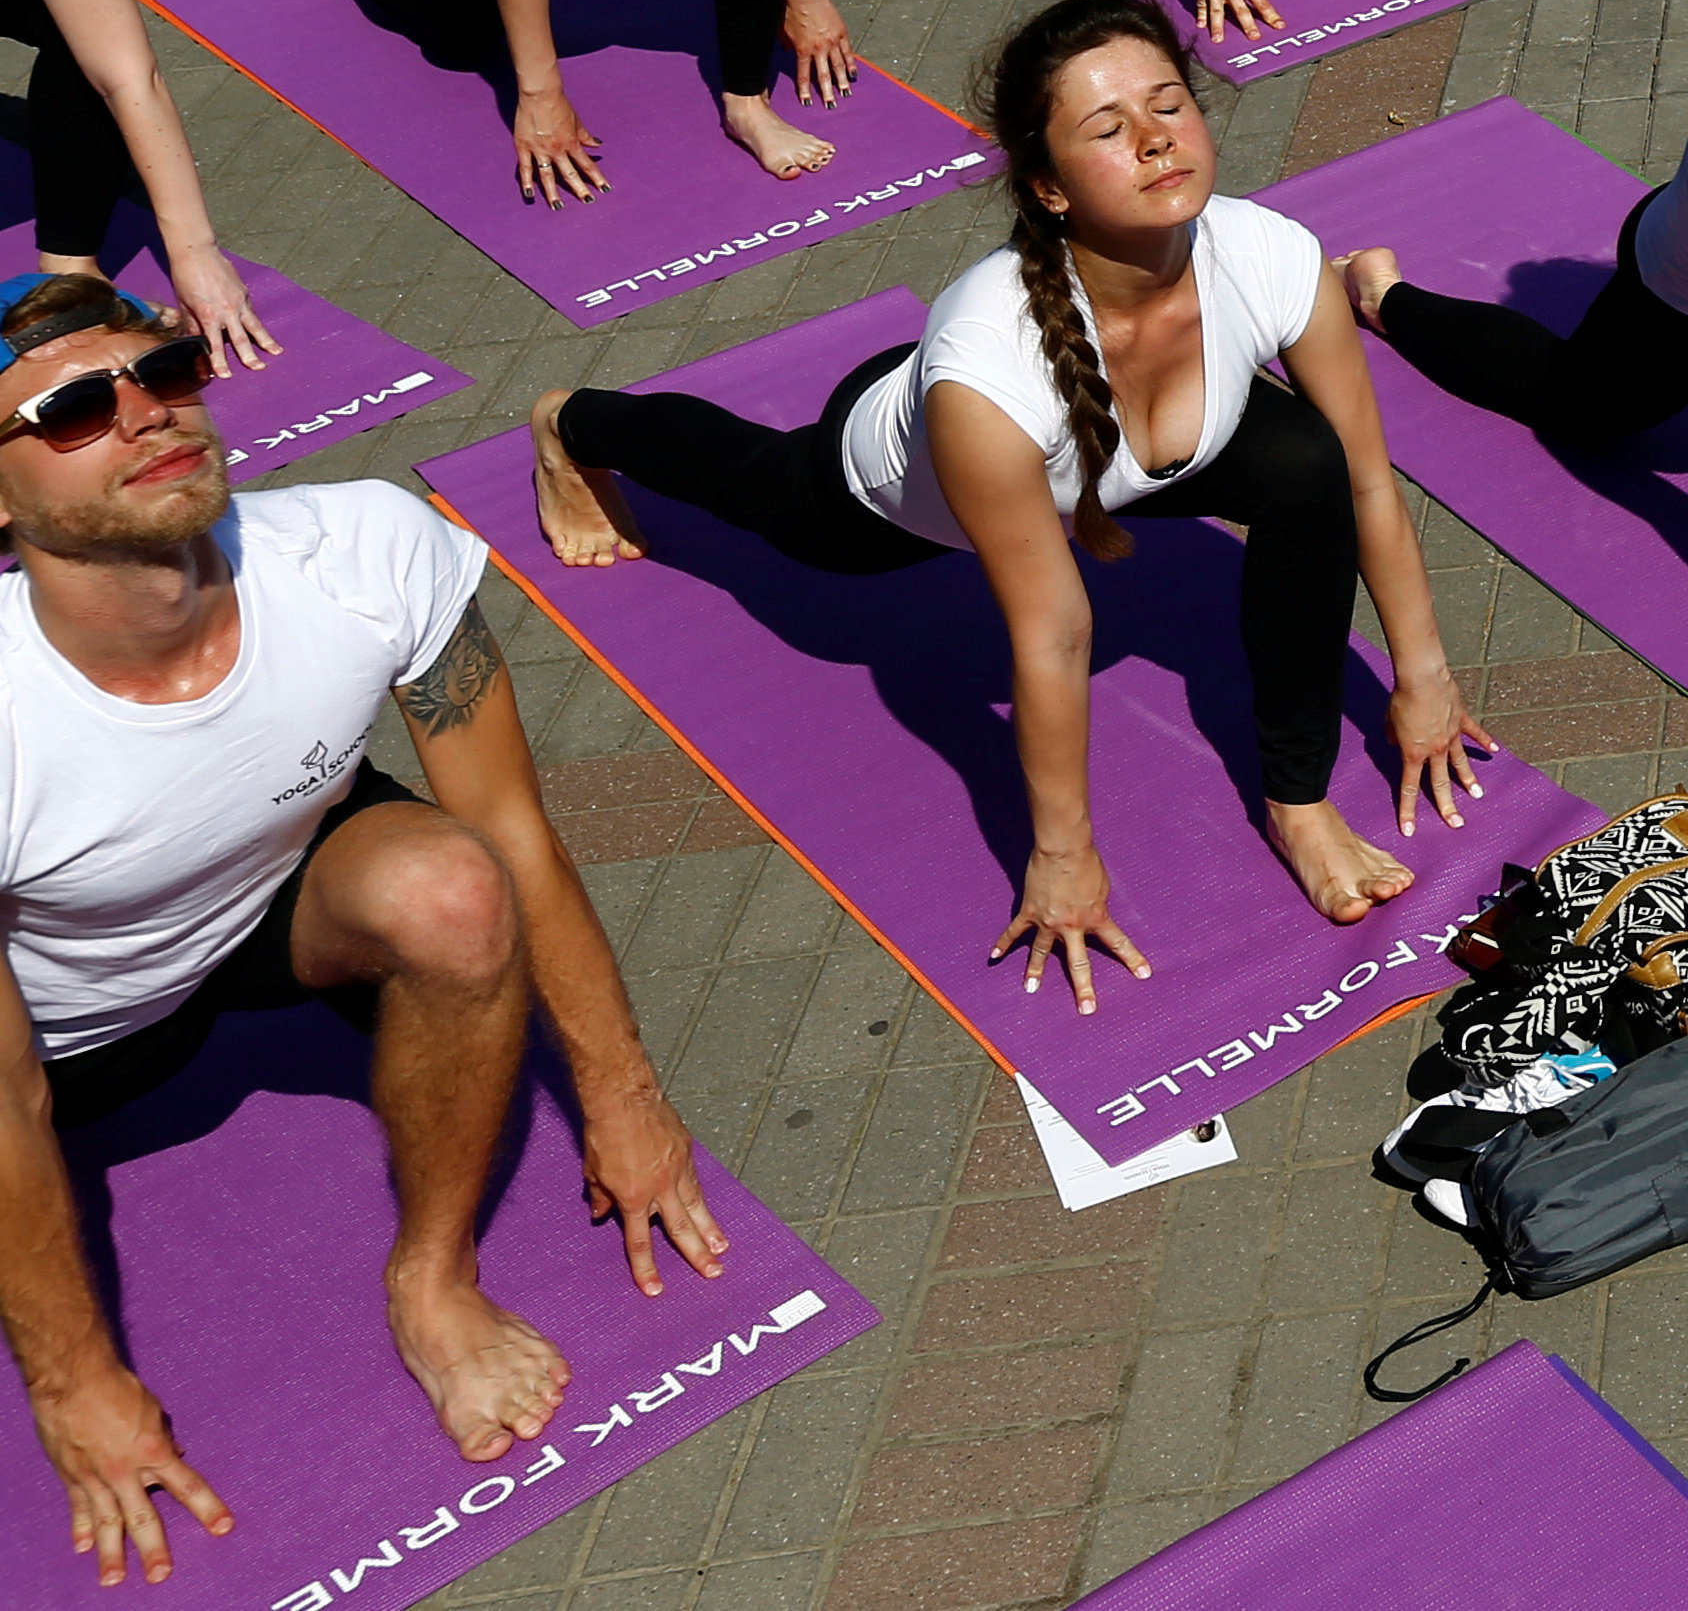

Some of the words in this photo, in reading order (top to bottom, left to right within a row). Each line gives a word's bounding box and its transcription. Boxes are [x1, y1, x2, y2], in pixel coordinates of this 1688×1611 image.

[835, 166, 962, 213] MARK
[576, 208, 830, 308] FORMELLE
[253, 388, 408, 449] MARK
[272, 775, 319, 806] YOGA
[1095, 939, 1419, 1127] FORMELLE
[574, 1325, 788, 1448] MARK
